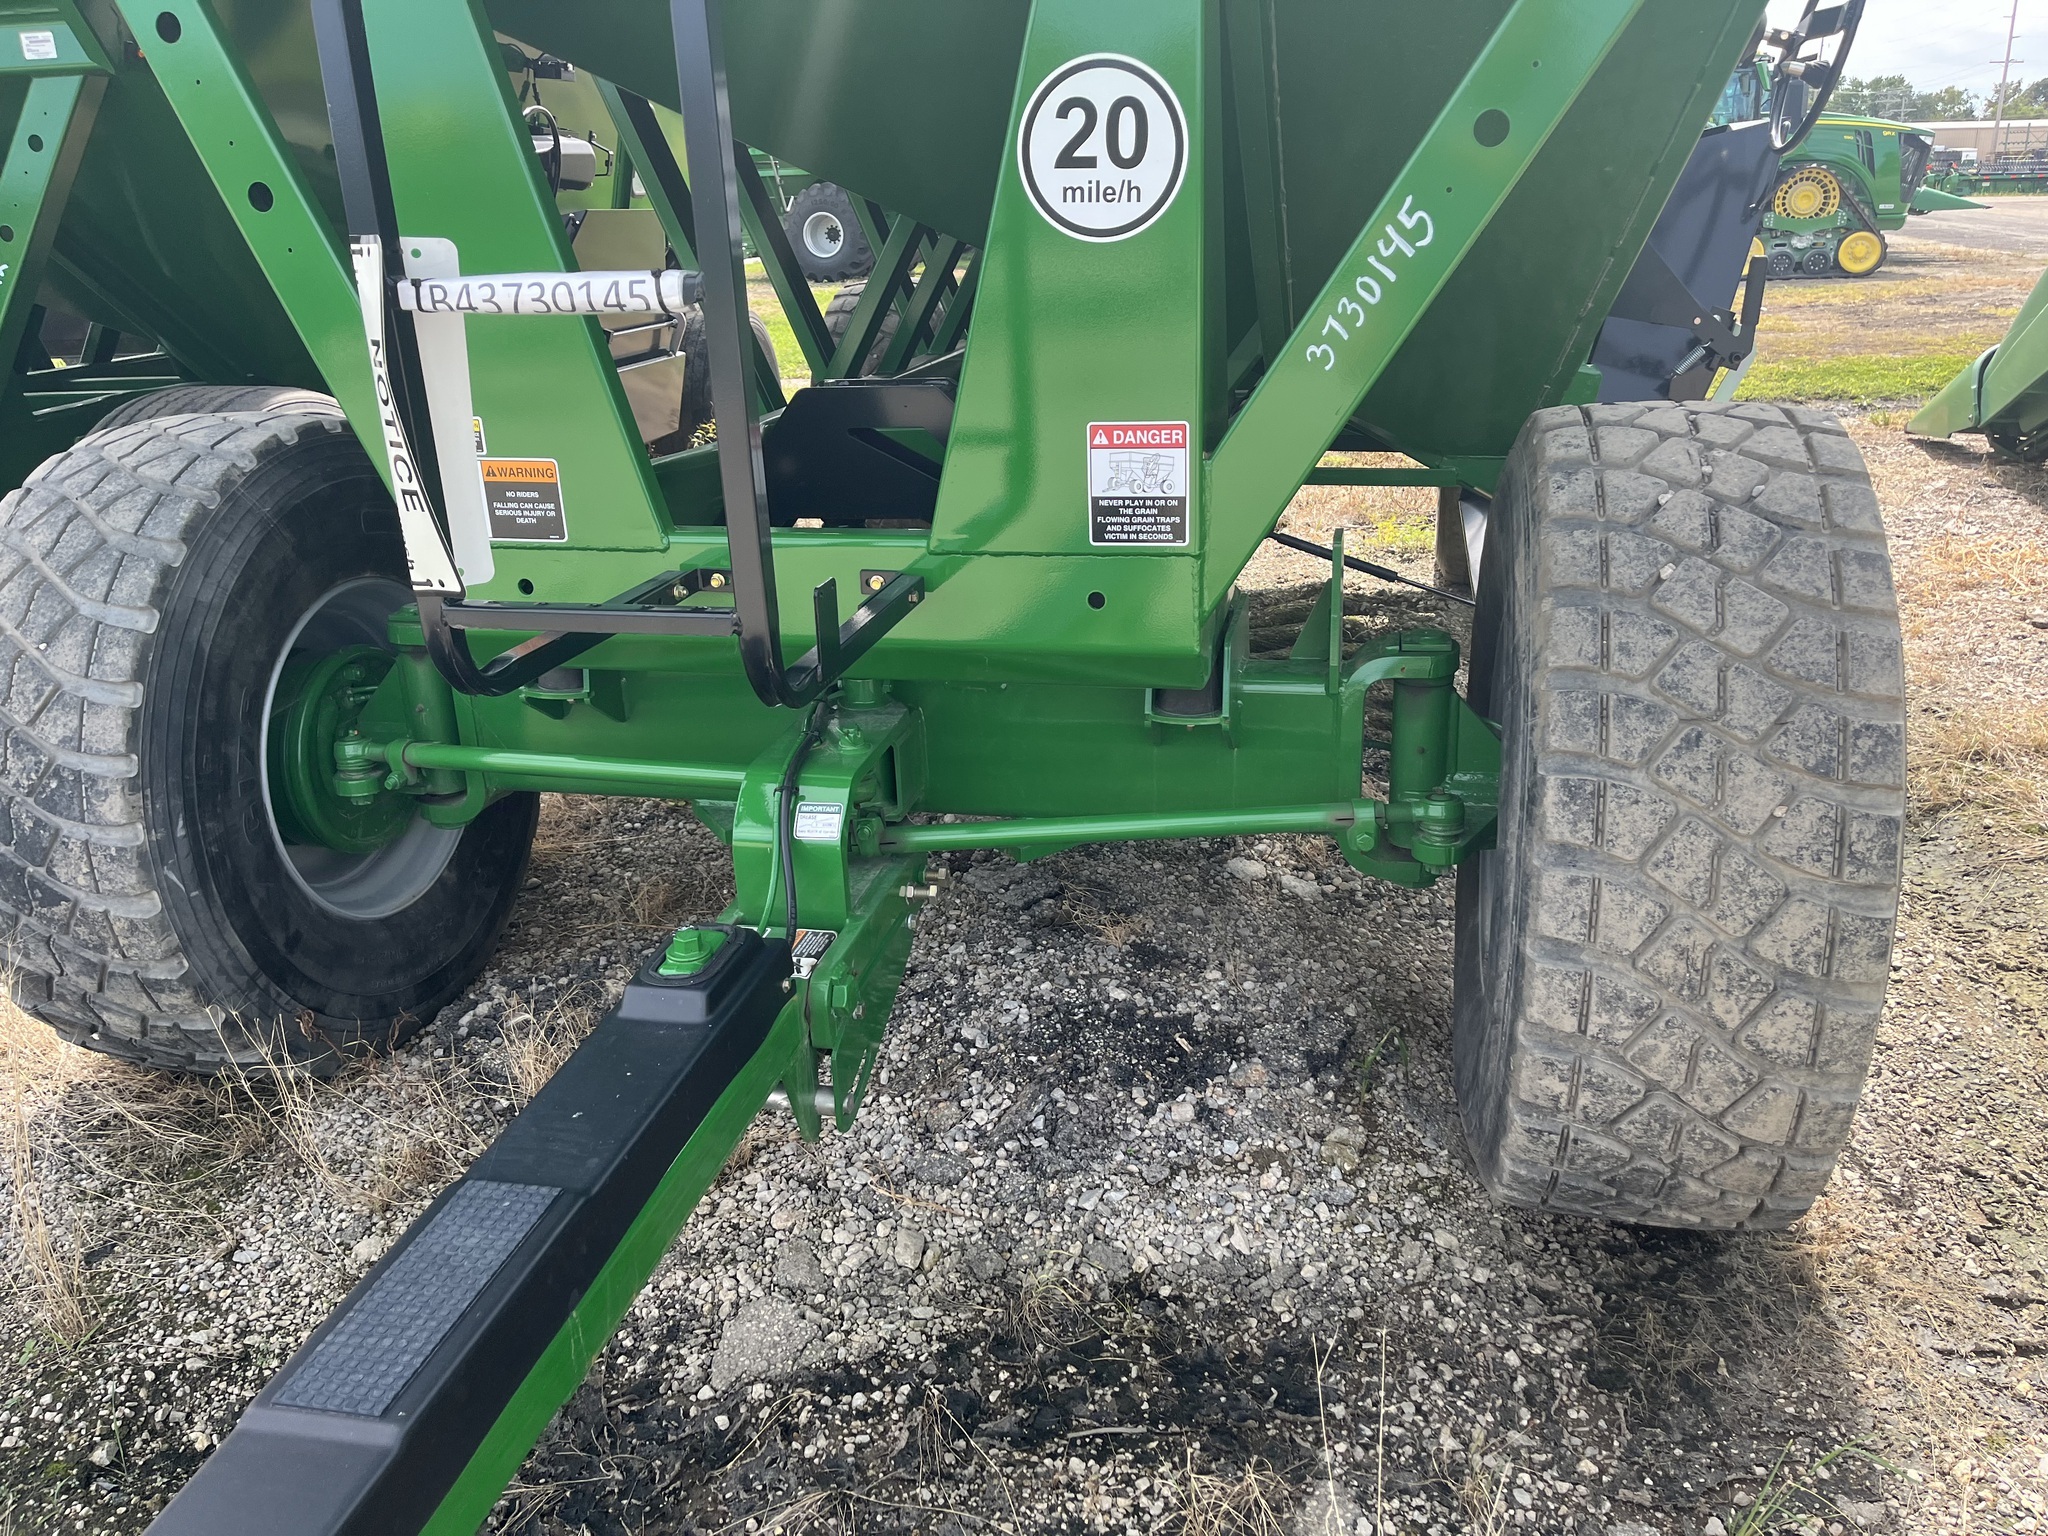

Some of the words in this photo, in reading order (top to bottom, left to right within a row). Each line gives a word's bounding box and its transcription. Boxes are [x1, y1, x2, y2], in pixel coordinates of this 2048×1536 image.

[1054, 95, 1149, 170] 20
[1062, 179, 1142, 204] mile/h
[1306, 194, 1434, 371] 3730145
[428, 279, 652, 314] R43730145
[370, 339, 426, 513] NOTICE
[1113, 429, 1183, 444] DANGER
[497, 467, 554, 479] WARNING
[493, 501, 519, 509] FALLING
[523, 509, 545, 517] INJURY
